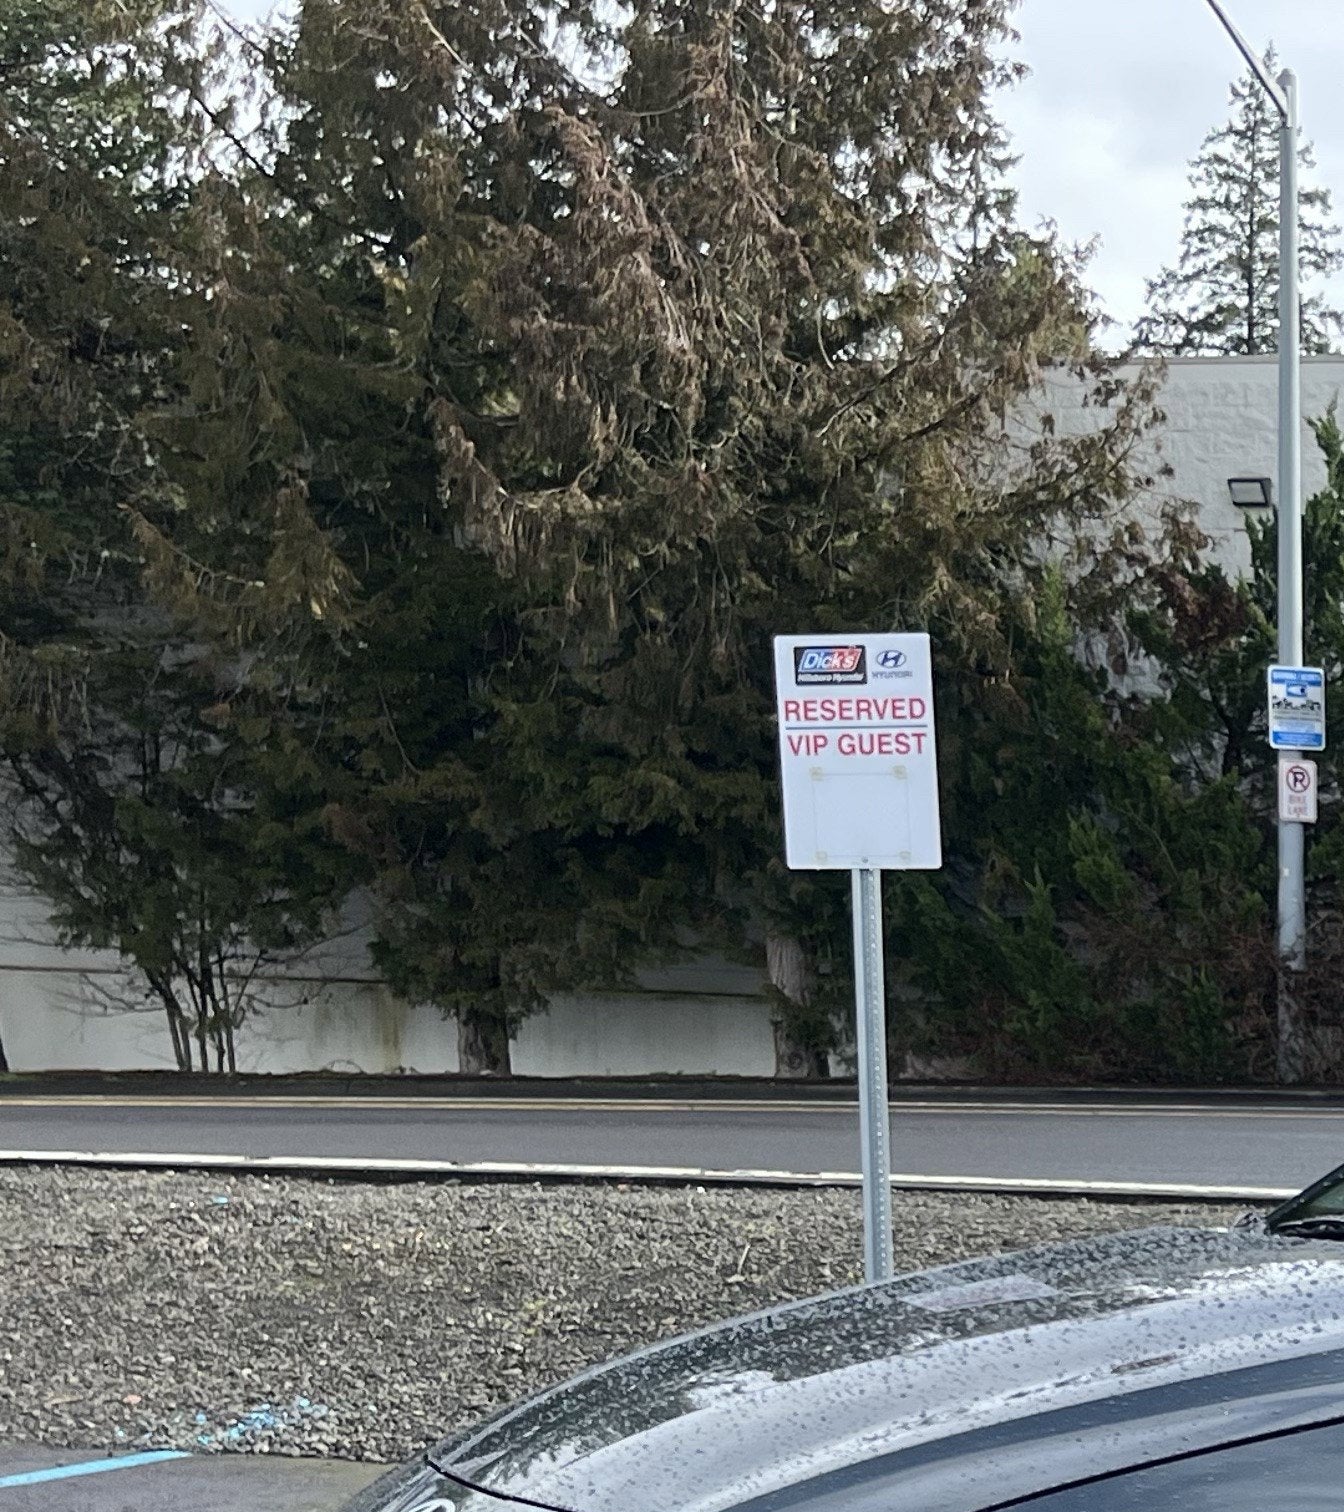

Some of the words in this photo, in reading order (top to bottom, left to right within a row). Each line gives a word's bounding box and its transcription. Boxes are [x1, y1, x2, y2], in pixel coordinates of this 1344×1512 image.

[784, 697, 927, 722] RESERVED
[787, 735, 828, 756] VIP
[837, 733, 927, 756] GUEST
